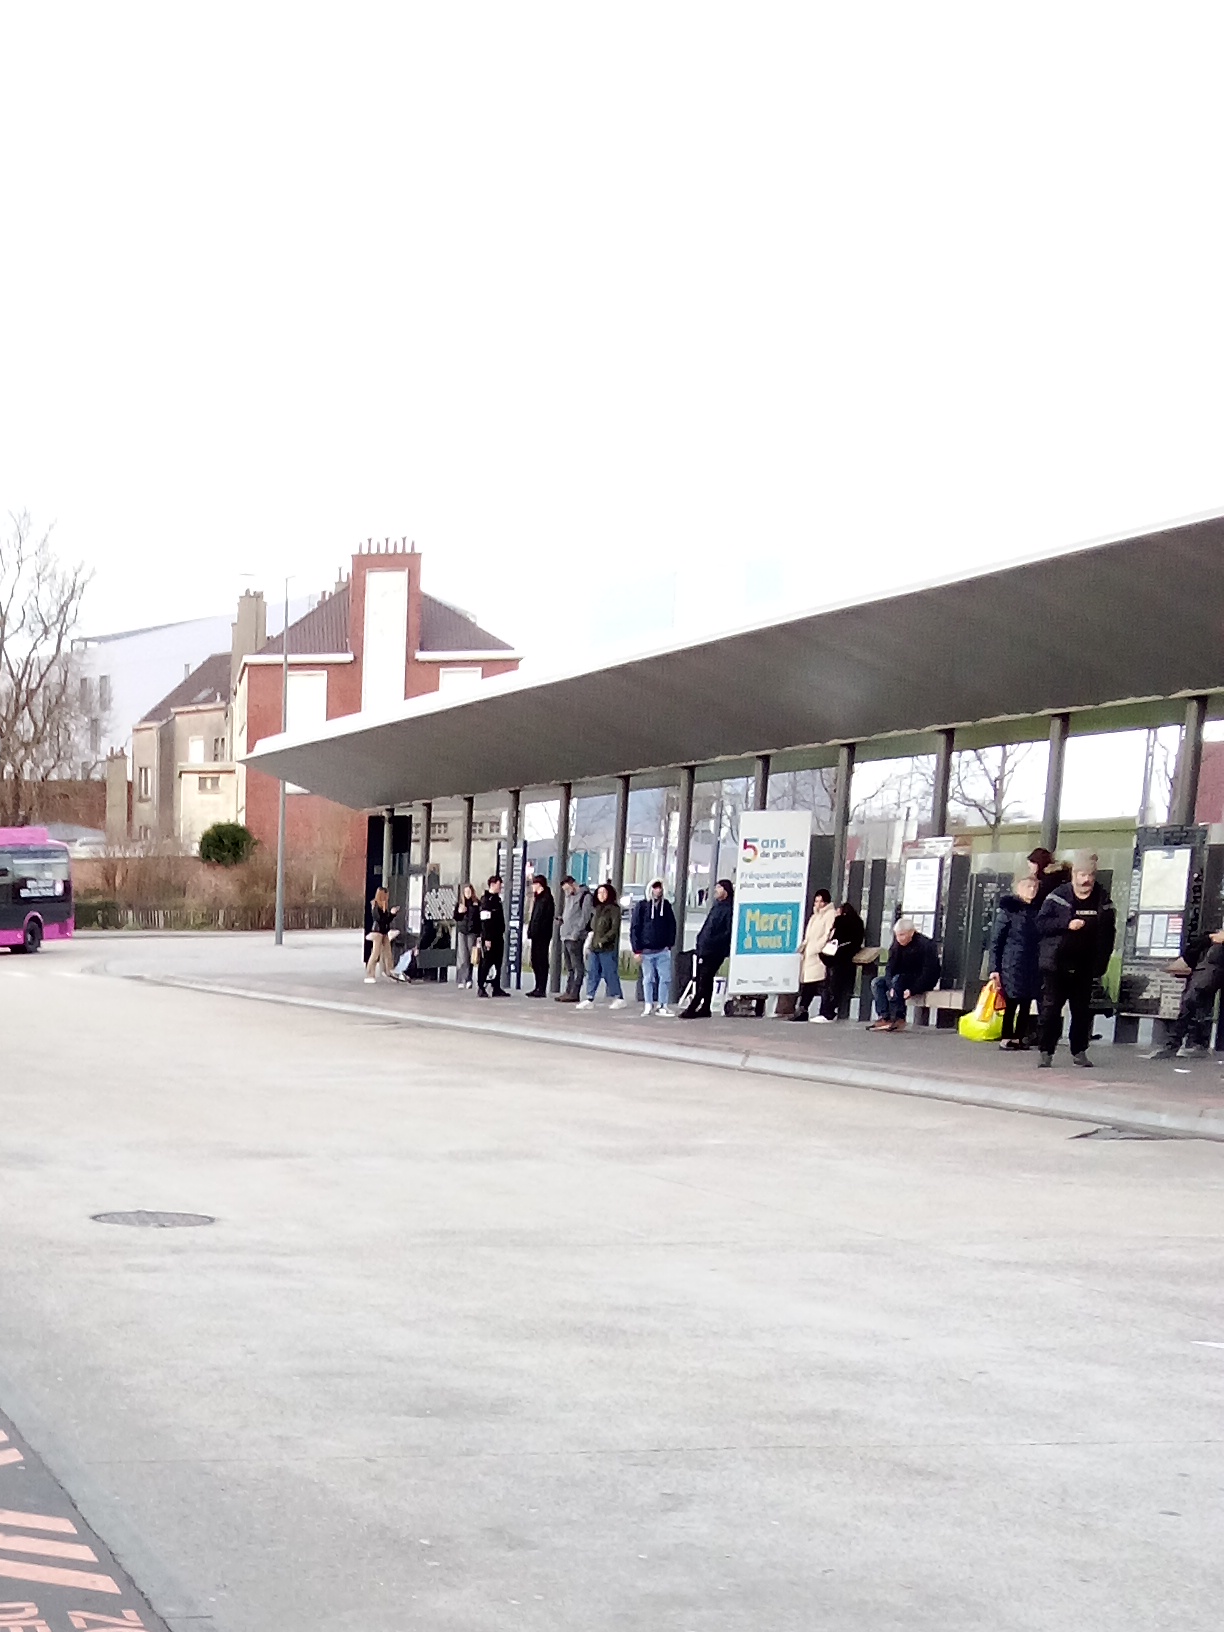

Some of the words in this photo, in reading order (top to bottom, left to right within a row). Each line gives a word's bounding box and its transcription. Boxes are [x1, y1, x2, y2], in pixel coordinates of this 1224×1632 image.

[742, 838, 758, 862] 5
[761, 839, 786, 849] ans
[745, 908, 792, 932] Merci
